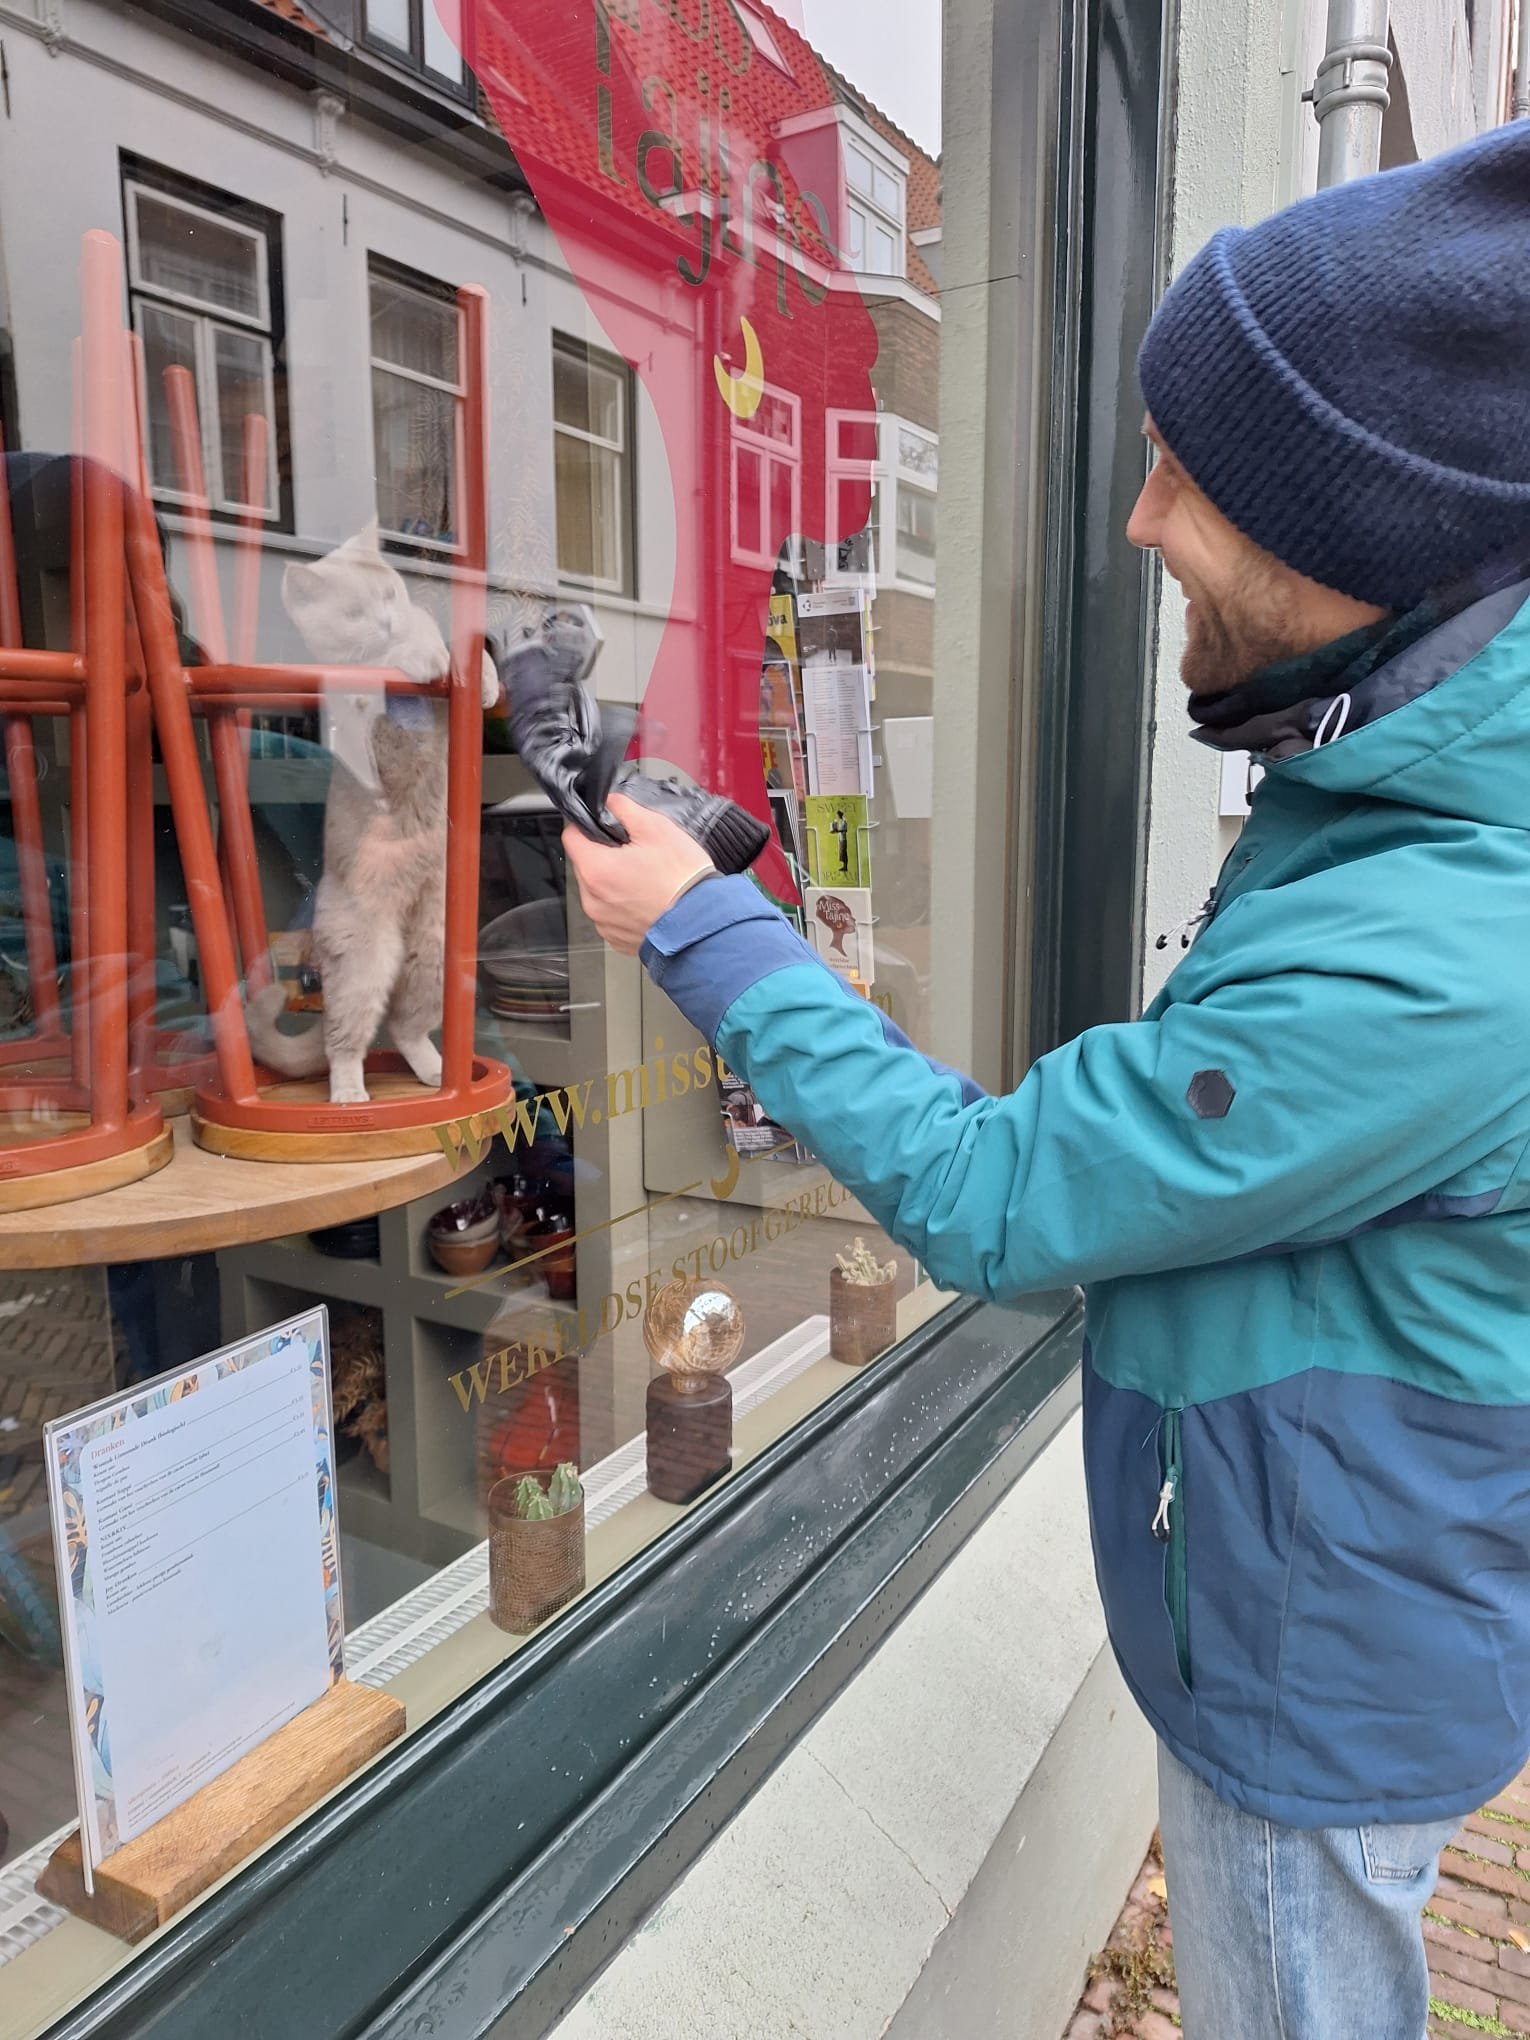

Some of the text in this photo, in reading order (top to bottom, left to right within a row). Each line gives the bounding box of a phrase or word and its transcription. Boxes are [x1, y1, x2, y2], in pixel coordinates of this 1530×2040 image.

[432, 1036, 733, 1172] www.misst
[447, 1269, 664, 1413] WERELDSE
[91, 1439, 125, 1460] Dranken
